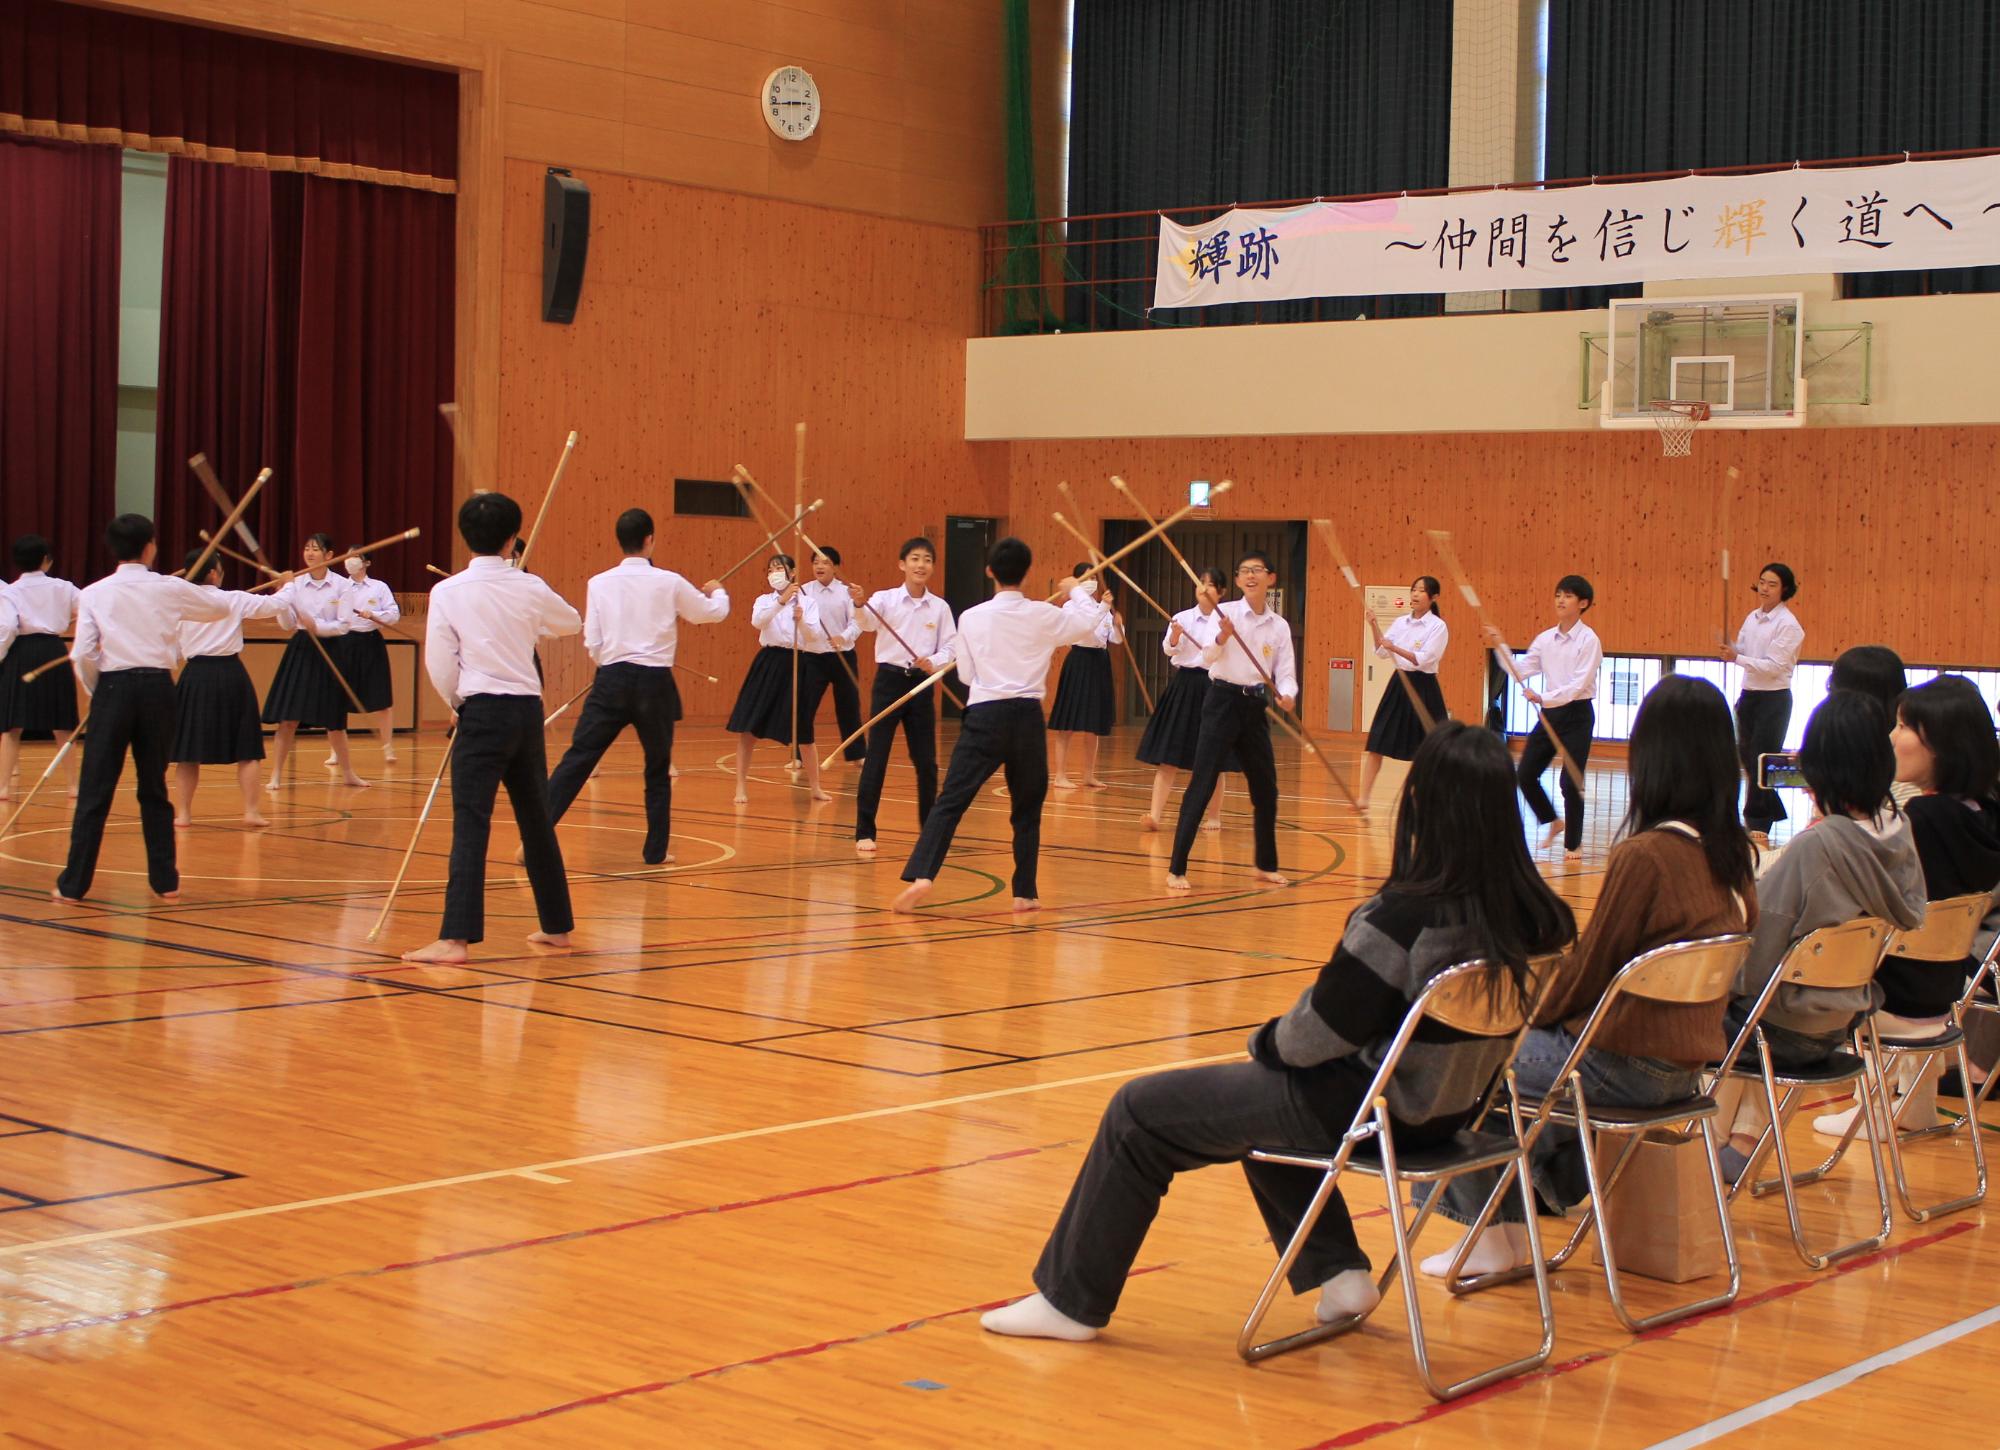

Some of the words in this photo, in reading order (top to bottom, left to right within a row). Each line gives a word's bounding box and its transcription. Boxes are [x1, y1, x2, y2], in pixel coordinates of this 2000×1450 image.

[788, 74, 797, 83] 12
[772, 85, 781, 94] 10
[804, 90, 811, 98] 2
[770, 95, 777, 104] 9
[772, 108, 779, 116] 8
[787, 124, 795, 133] 6
[1189, 226, 1280, 285] 輝跡
